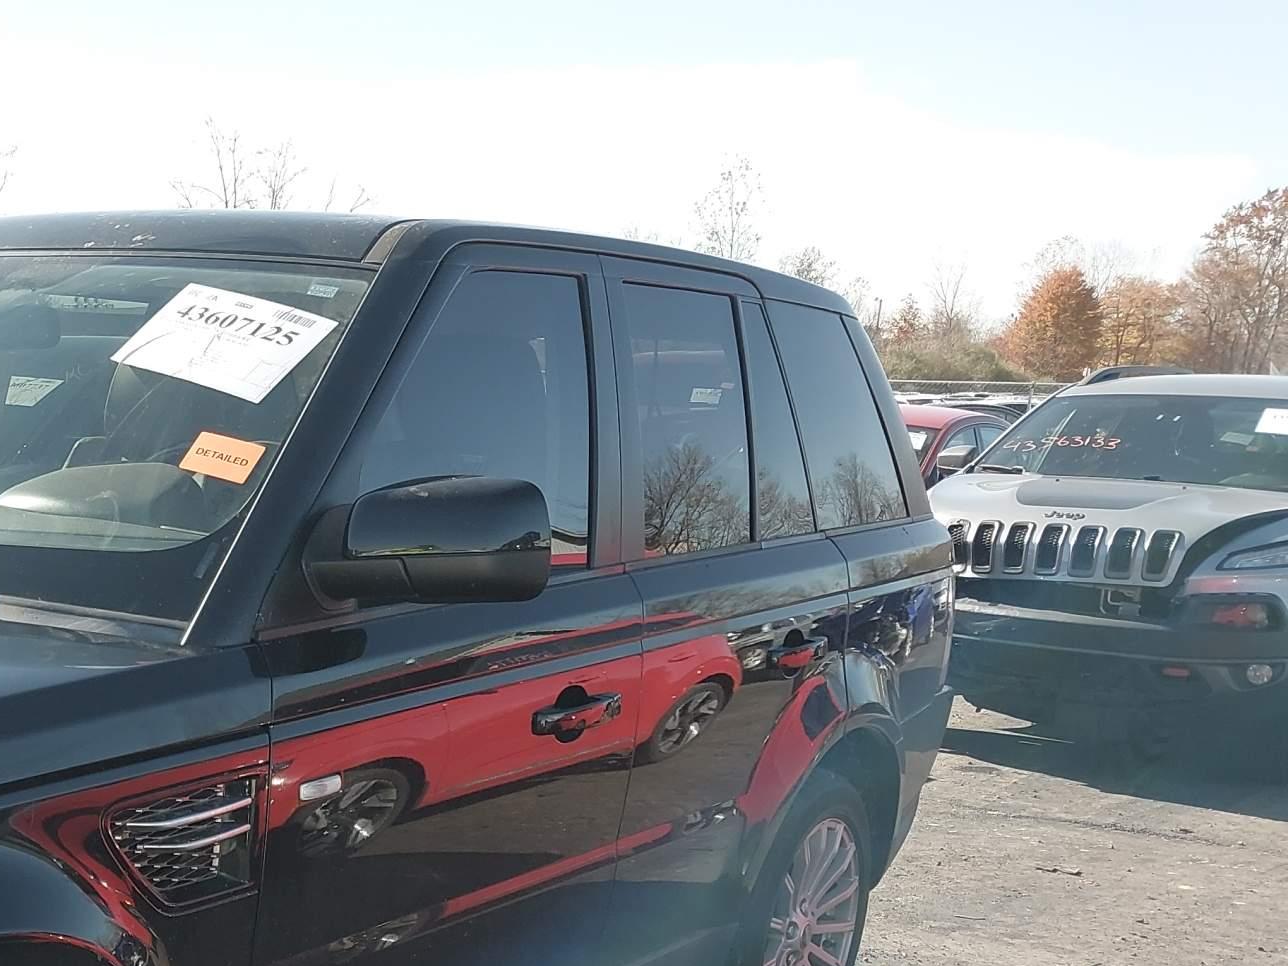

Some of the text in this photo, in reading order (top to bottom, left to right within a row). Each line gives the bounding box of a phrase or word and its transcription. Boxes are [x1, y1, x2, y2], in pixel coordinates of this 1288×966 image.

[176, 304, 301, 346] 43607125
[195, 447, 249, 467] DETAILED
[1044, 510, 1086, 521] Jeep
